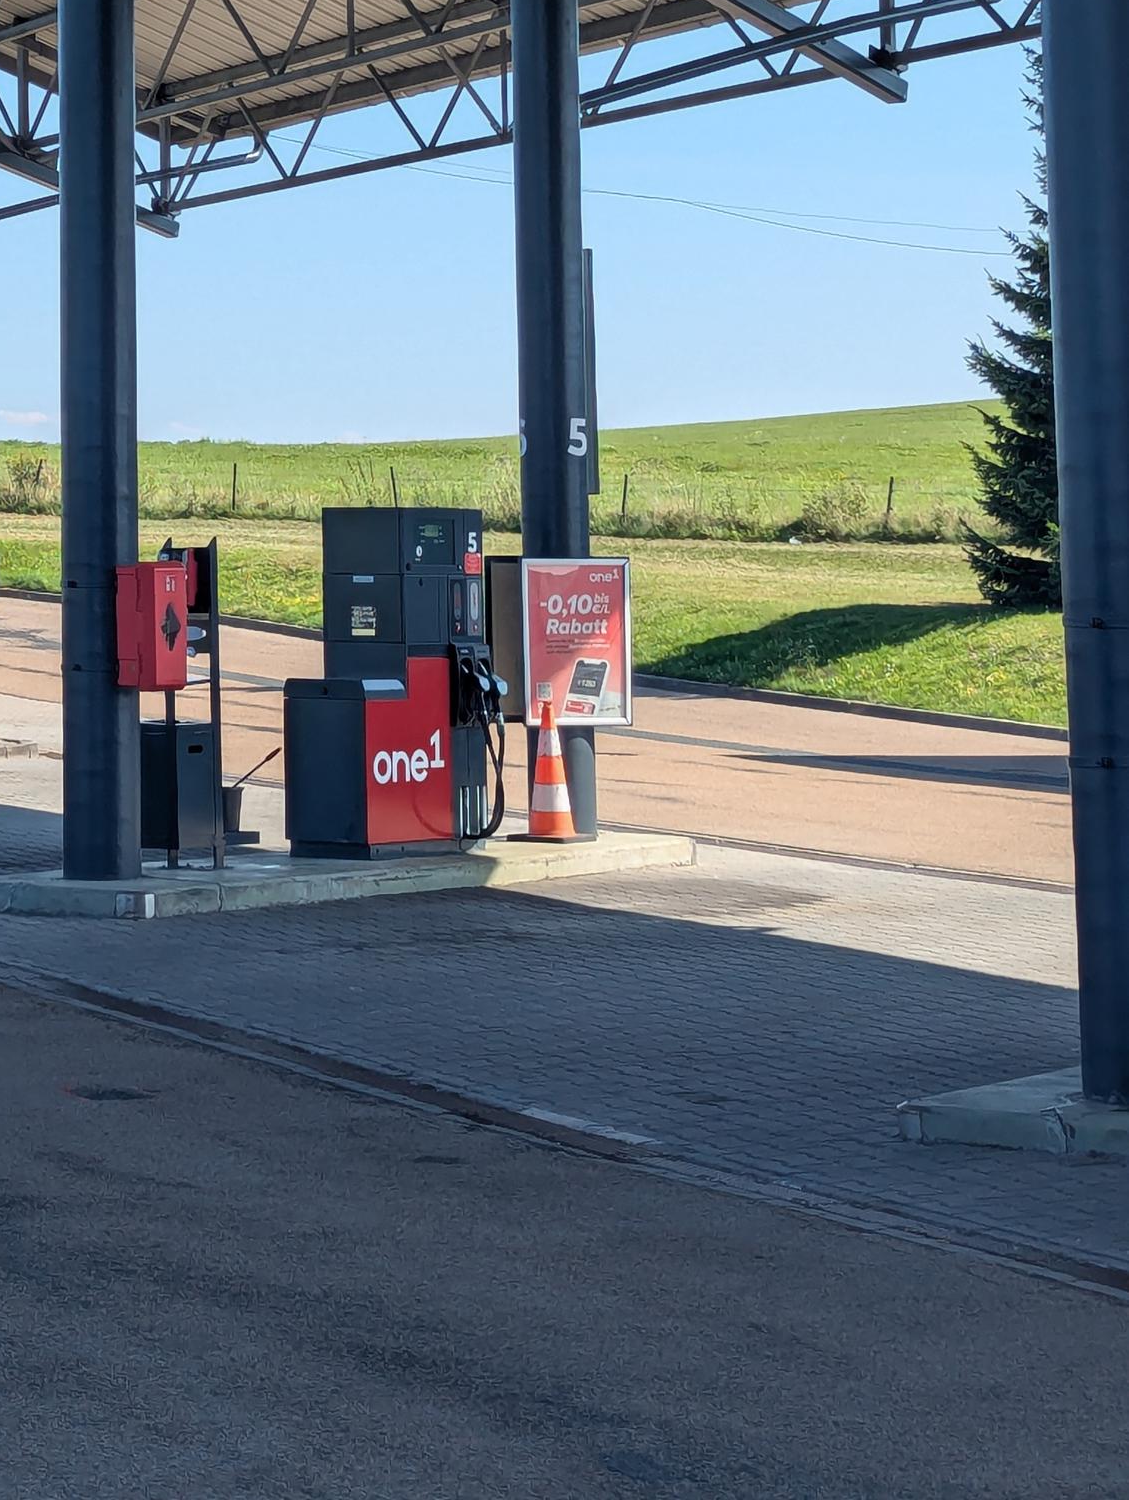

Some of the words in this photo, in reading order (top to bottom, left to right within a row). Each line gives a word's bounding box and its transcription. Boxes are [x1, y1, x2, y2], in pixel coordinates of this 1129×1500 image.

[567, 417, 588, 457] 5
[468, 531, 478, 553] 5
[539, 594, 593, 618] -0,10
[546, 618, 608, 635] Rabatt
